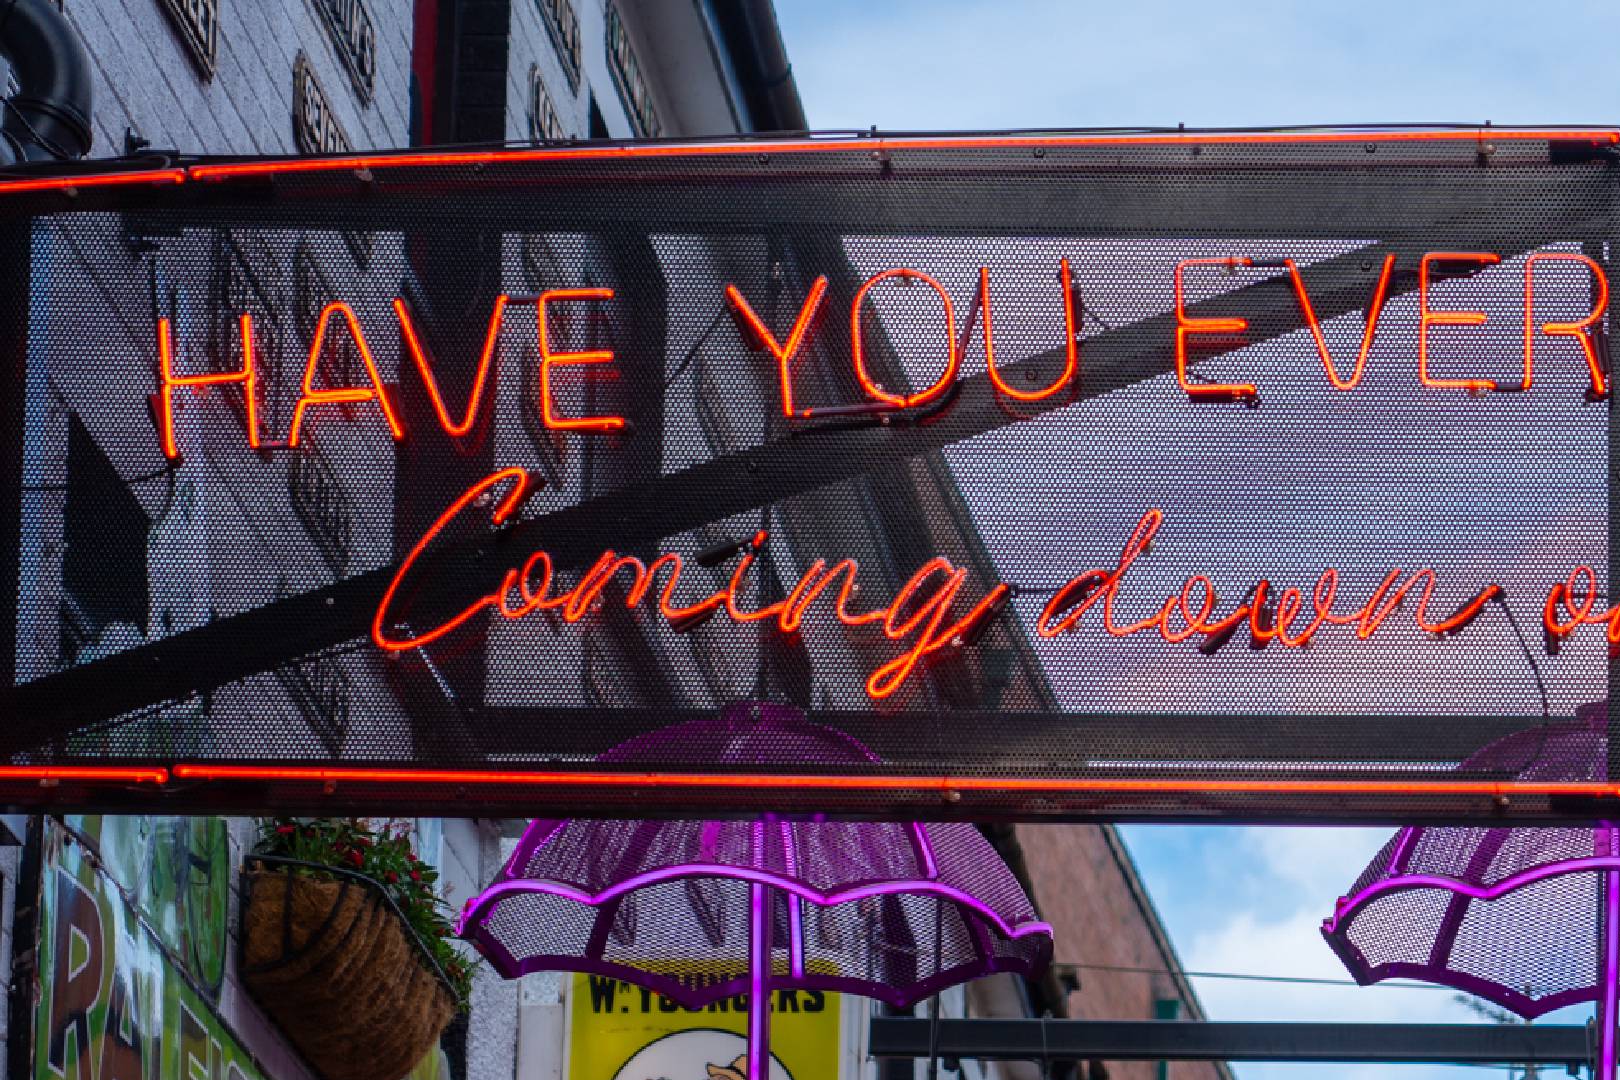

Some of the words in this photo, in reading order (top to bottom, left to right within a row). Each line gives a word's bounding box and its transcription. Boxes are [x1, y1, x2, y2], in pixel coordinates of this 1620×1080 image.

[158, 287, 626, 460] HAVE
[726, 257, 1078, 418] YOU
[1174, 251, 1610, 396] EVER
[372, 467, 1010, 699] Coming
[1037, 508, 1500, 648] down
